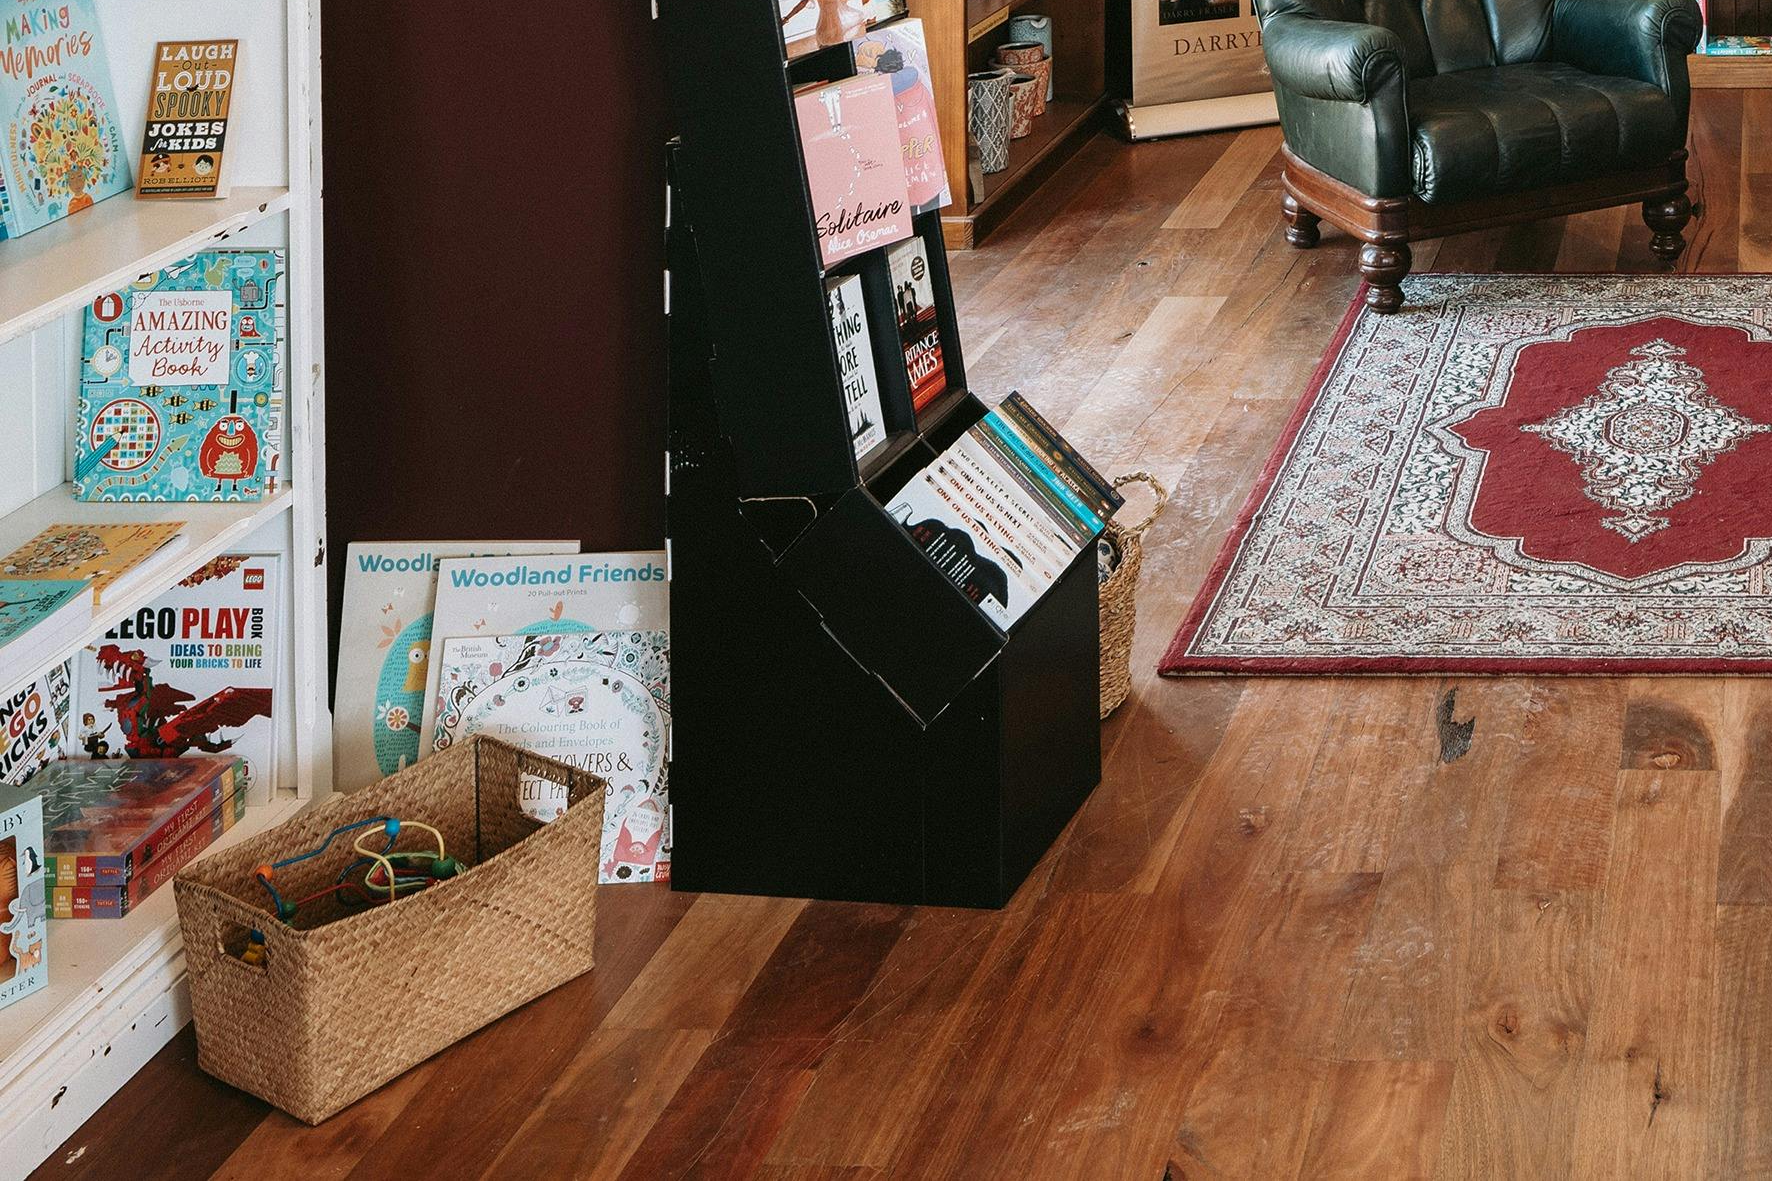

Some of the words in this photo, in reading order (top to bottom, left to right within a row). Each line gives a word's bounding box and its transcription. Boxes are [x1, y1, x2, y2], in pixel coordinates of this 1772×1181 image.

[6, 5, 69, 44] MAKING
[161, 44, 234, 61] LAUGH
[156, 70, 231, 92] LOUD
[154, 90, 227, 119] SPOOKY
[148, 121, 225, 137] JOKES
[815, 199, 904, 240] Solitaire
[159, 297, 172, 307] The
[173, 297, 205, 307] Usborne
[134, 309, 228, 332] AMAZING
[134, 334, 224, 362] Activity
[151, 357, 209, 377] Book
[844, 374, 868, 406] TELL
[936, 487, 951, 503] ONE
[952, 502, 962, 514] OF
[962, 512, 972, 523] US
[972, 522, 980, 532] IS
[979, 532, 1002, 556] LYING
[950, 477, 965, 492] ONE
[965, 491, 975, 503] OF
[975, 501, 985, 512] US
[985, 511, 994, 521] IS
[993, 520, 1015, 544] LYING
[244, 574, 262, 584] LEGO
[451, 566, 571, 588] Woodland
[579, 563, 665, 583] Friends
[527, 589, 537, 597] 20
[538, 588, 564, 598] Pull-out
[567, 588, 588, 597] Prints
[250, 607, 264, 639] BOOK
[170, 644, 204, 657] IDEAS
[207, 644, 222, 657] TO
[225, 644, 262, 657] BRING
[460, 652, 489, 660] Museum
[170, 658, 194, 669] YOUR
[195, 658, 229, 669] BRICKS
[231, 658, 242, 668] TO
[244, 658, 262, 668] LIFE
[496, 723, 518, 735] The
[521, 721, 576, 736] Colouring
[579, 720, 608, 733] Book
[611, 718, 624, 732] of
